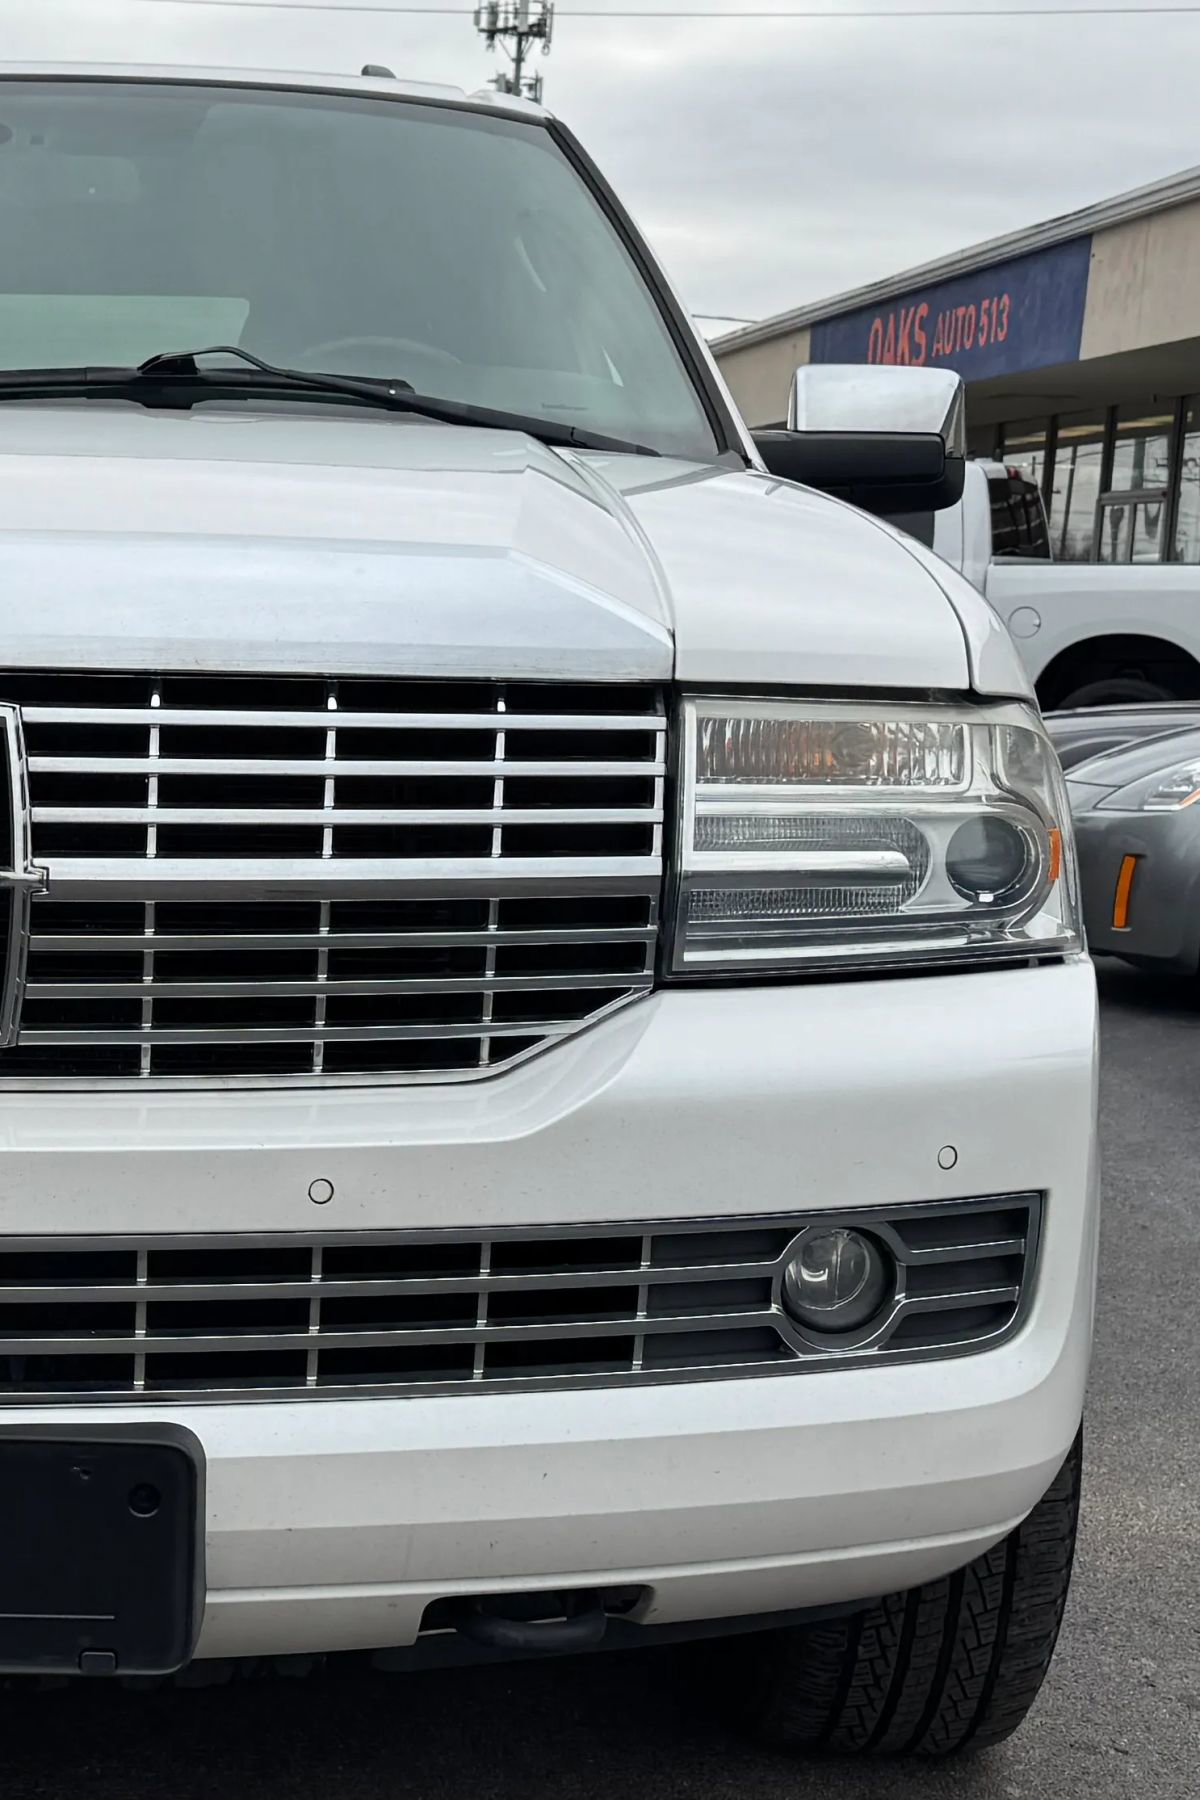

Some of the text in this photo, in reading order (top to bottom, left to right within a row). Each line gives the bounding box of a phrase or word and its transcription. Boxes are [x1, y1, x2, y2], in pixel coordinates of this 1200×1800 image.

[868, 293, 1010, 366] OAKS AUTO 513
